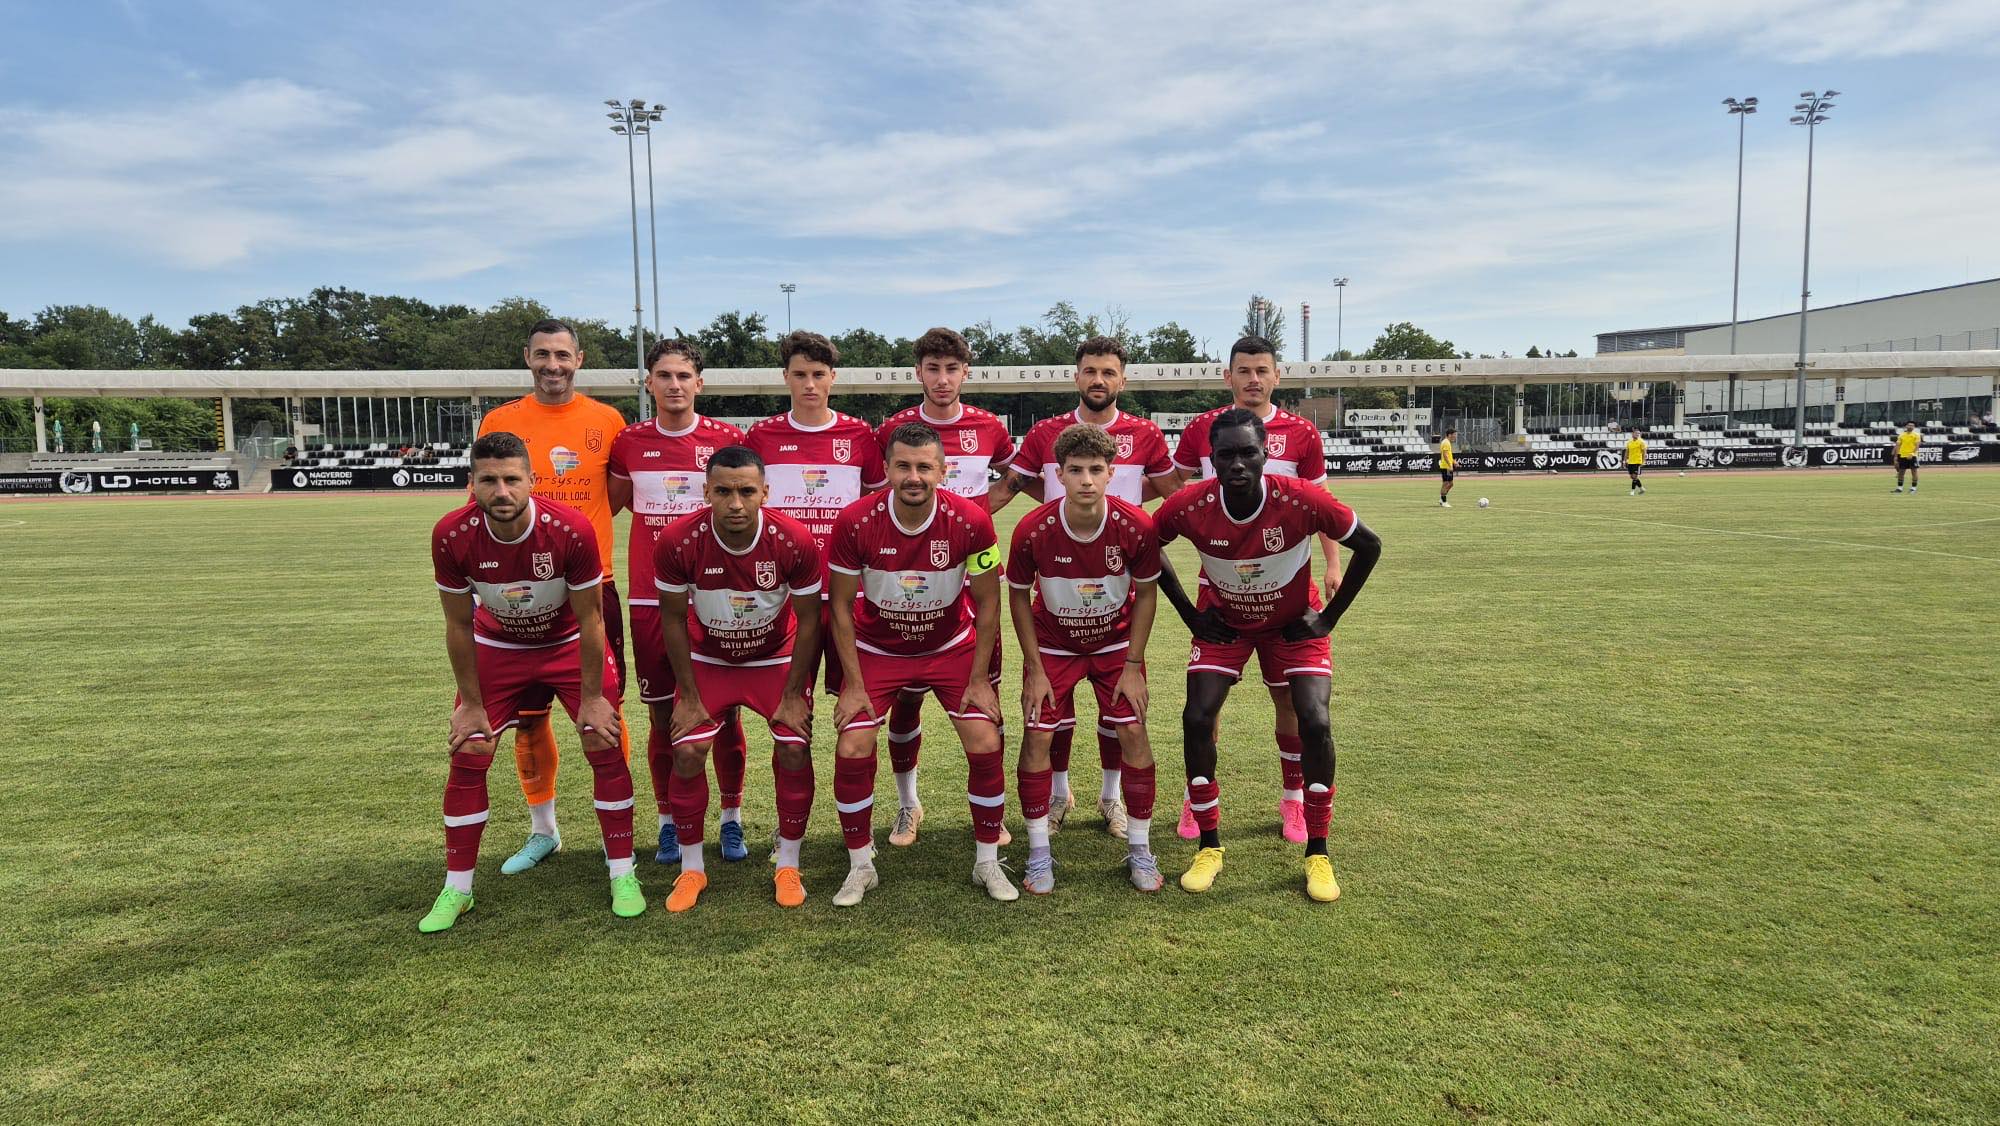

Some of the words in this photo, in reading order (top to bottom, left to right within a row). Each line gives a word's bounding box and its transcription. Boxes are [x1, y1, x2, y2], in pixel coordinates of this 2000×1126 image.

[875, 370, 1000, 381] DEBENI
[1156, 366, 1292, 377] UNIVEY
[1309, 364, 1331, 374] OF
[1350, 363, 1462, 374] DEBRECEN
[1840, 448, 1884, 459] UNIFIT
[1456, 457, 1479, 465] AGISZ
[1550, 454, 1591, 466] yoUDay
[136, 476, 197, 485] HOTELS
[413, 472, 454, 483] Delta
[570, 491, 592, 501] LOCAL
[783, 495, 842, 506] m-sys.ro
[645, 502, 704, 513] m-sys.ro
[1210, 539, 1229, 547] JAKO
[879, 547, 897, 555] JAKO
[977, 551, 993, 570] C
[1054, 555, 1072, 563] JAKO
[479, 561, 499, 569] JAKO
[704, 567, 724, 575] JAKO
[1219, 580, 1279, 593] m-sys.ro
[1258, 590, 1284, 603] LOCAL
[880, 599, 943, 611] m-sys.ro
[1058, 603, 1117, 616] m-sys.ro
[533, 610, 560, 624] LOCAL
[880, 609, 920, 622] CONSILIUL
[920, 609, 945, 622] LOCAL
[526, 622, 551, 633] MARE
[710, 615, 771, 629] m-sys.ro
[889, 622, 910, 631] SATU
[911, 622, 935, 633] MARE
[1058, 617, 1098, 627] CONSILIUL
[708, 628, 751, 639] CONSILIUL
[752, 623, 775, 638] LOCAL
[1070, 630, 1090, 638] SATU
[720, 641, 742, 649] SATU
